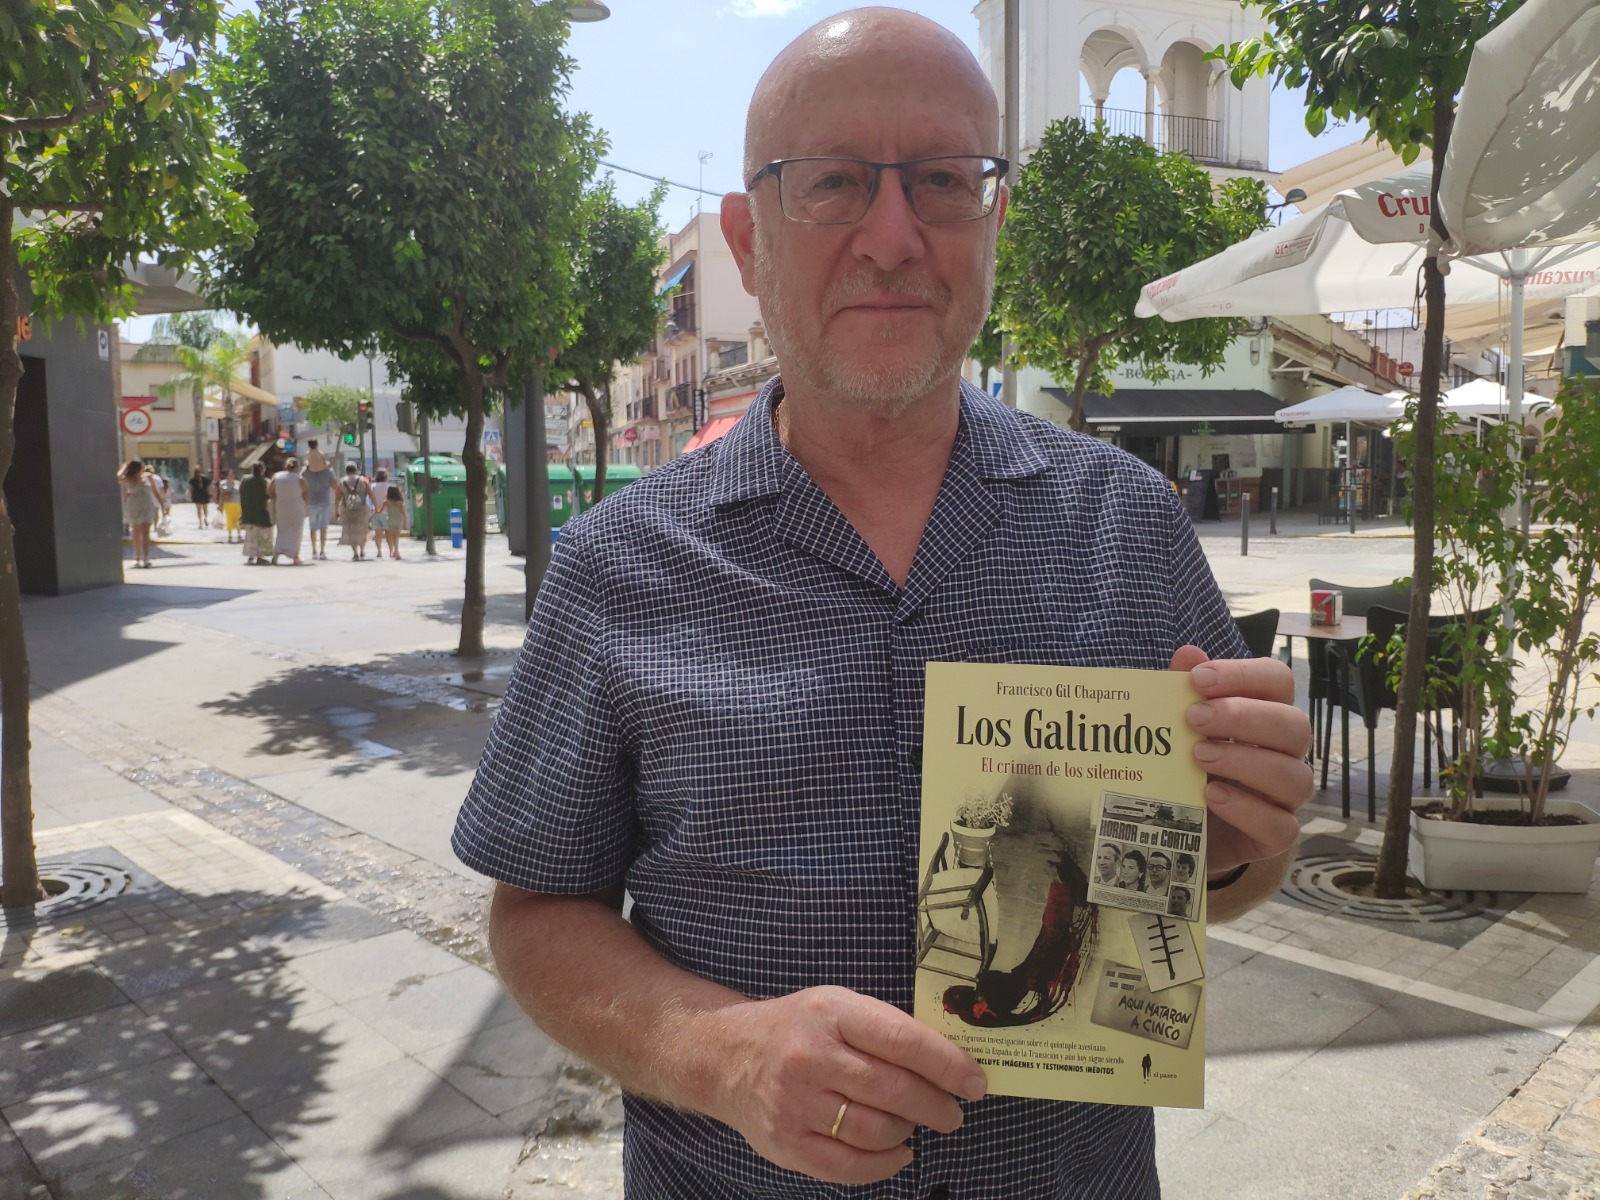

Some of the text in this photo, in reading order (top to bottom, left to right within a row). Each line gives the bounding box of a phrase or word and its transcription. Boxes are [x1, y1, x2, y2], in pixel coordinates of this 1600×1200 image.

[1377, 192, 1431, 218] Cru
[996, 681, 1130, 703] Francisco Gil Chaparro
[956, 705, 1172, 756] Los Galindos
[981, 756, 1143, 782] El crimen de los silencios
[1099, 819, 1201, 852] HORROR en el CORTIJO
[1118, 995, 1192, 1024] AQUI MATARON
[1130, 1016, 1180, 1041] A CINCO
[960, 1045, 984, 1053] ocionó
[985, 1046, 991, 1055] la
[991, 1046, 1012, 1057] España
[1013, 1048, 1020, 1057] de
[1021, 1049, 1027, 1058] la
[1028, 1049, 1059, 1060] Transición
[1077, 1053, 1087, 1064] hoy
[1088, 1054, 1104, 1064] sigue
[1105, 1055, 1125, 1064] siendo
[961, 1034, 987, 1044] rigurosa
[987, 1035, 1026, 1047] investigación
[1026, 1038, 1043, 1048] sobre
[1044, 1039, 1049, 1048] el
[1078, 1043, 1106, 1052] asesinato
[1002, 1058, 1034, 1069] IMÁGENES
[1036, 1062, 1041, 1070] Y
[1042, 1062, 1084, 1072] TESTIMONIOS
[1085, 1064, 1115, 1075] INÉDITOS
[1159, 1072, 1178, 1080] paseo
